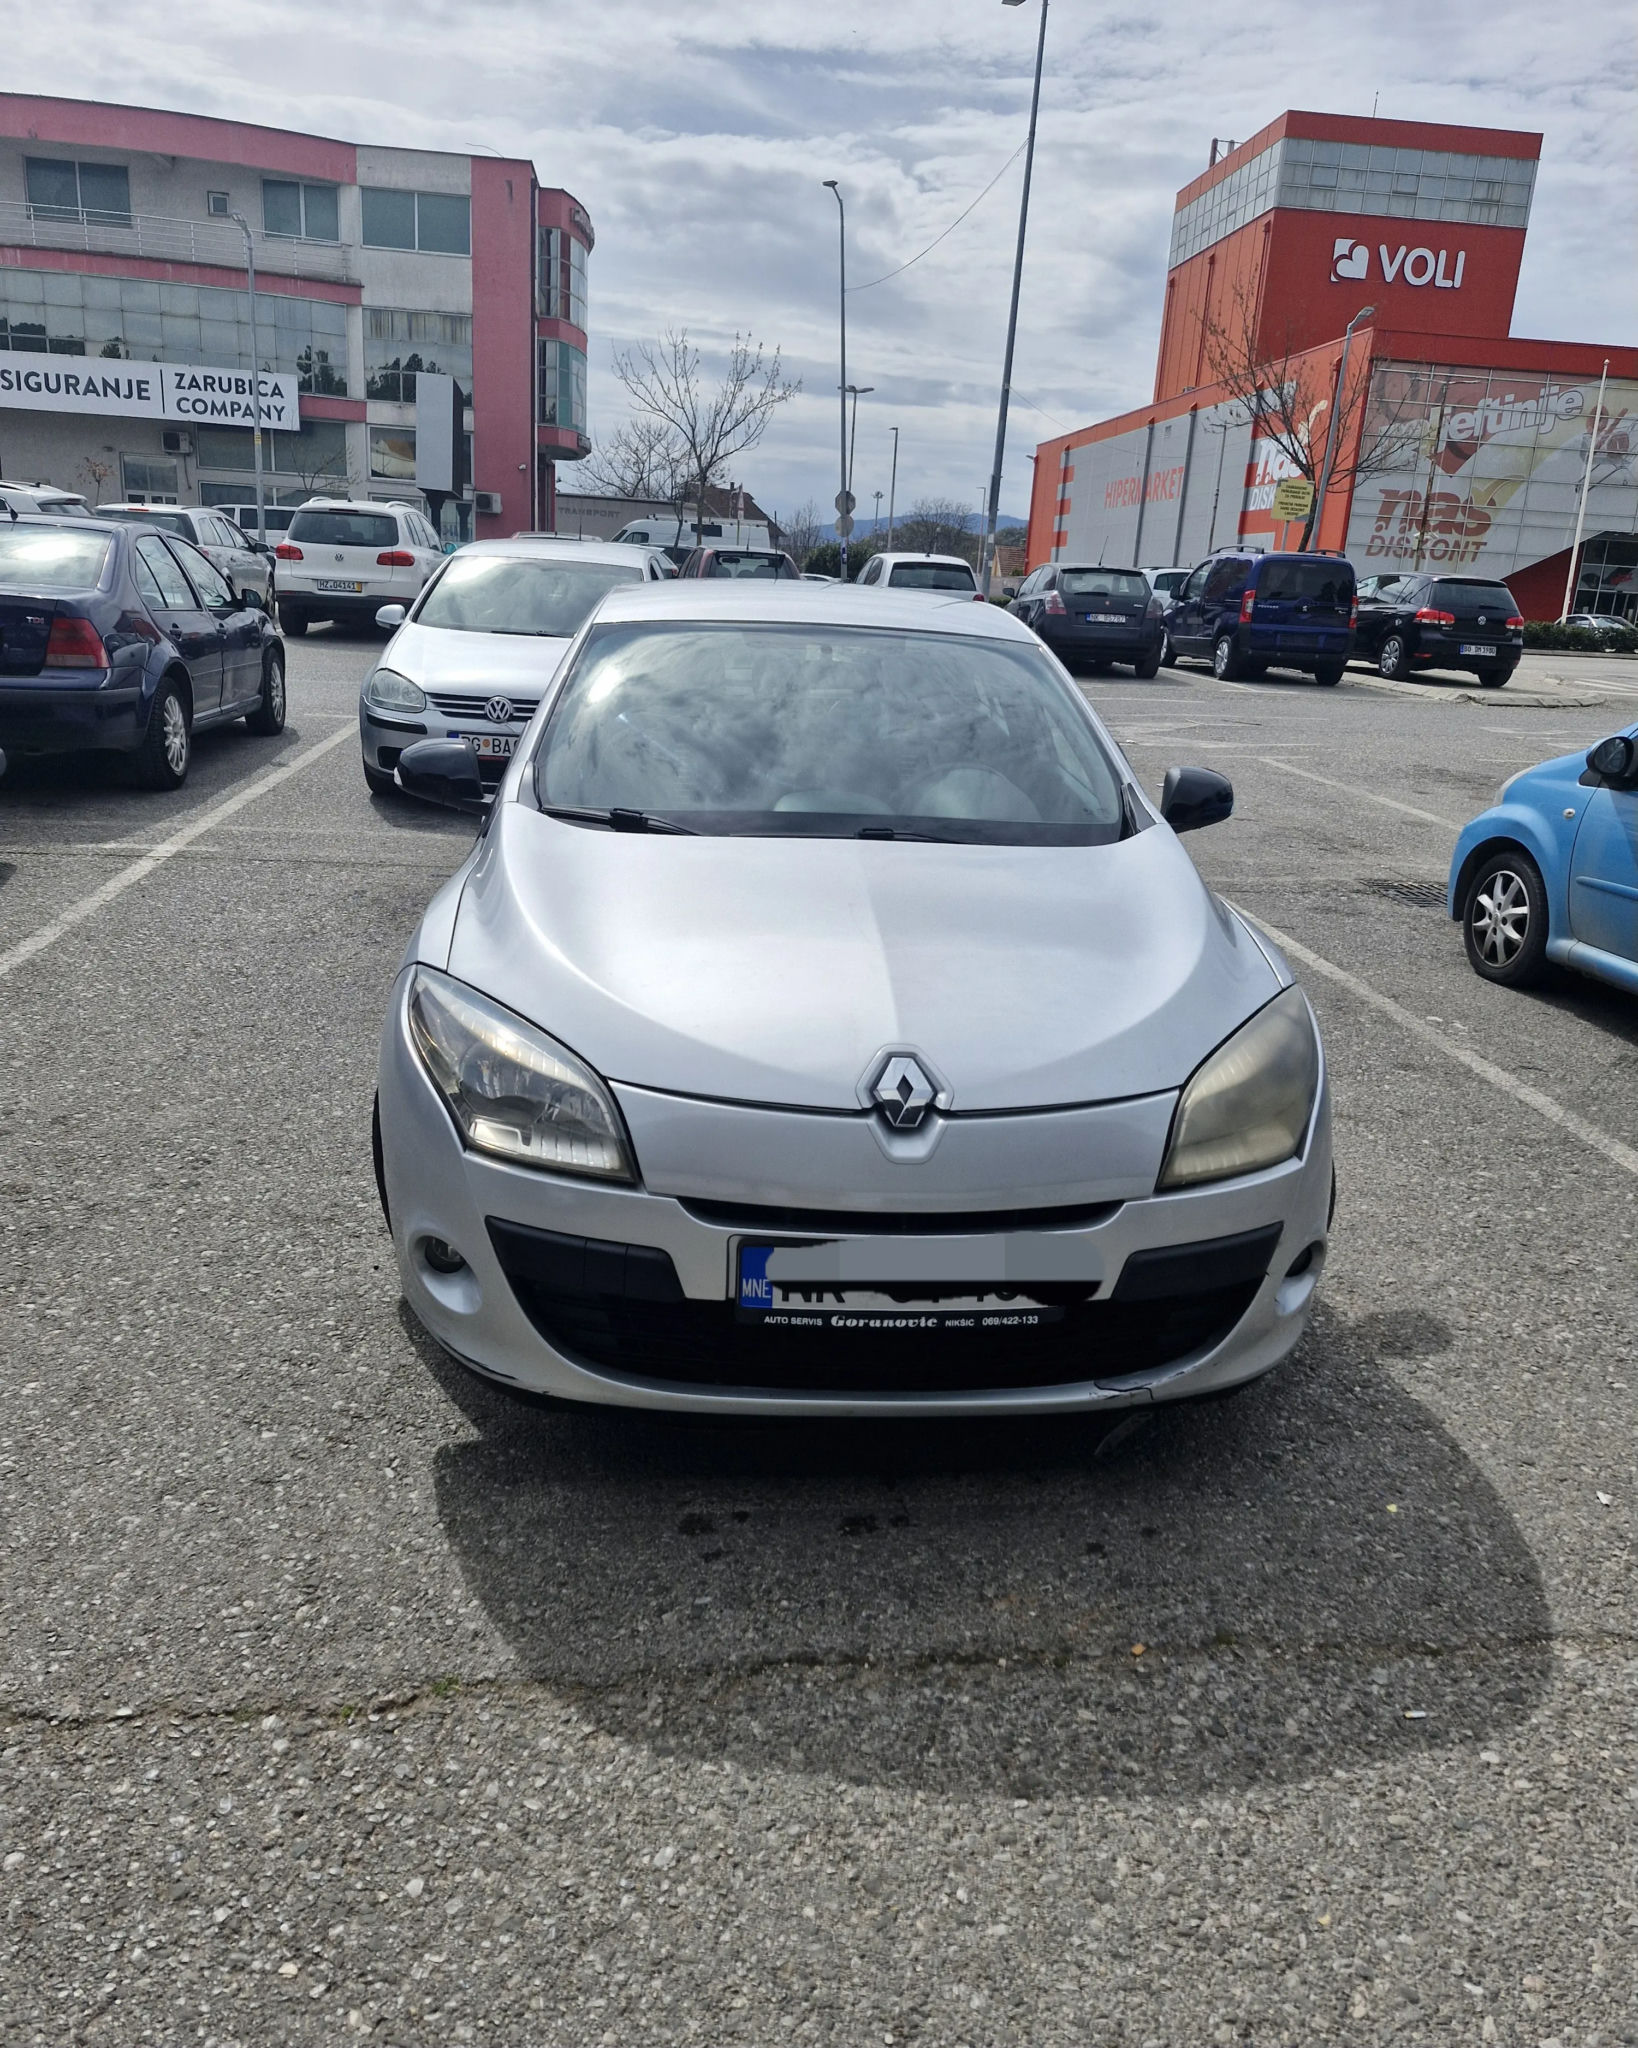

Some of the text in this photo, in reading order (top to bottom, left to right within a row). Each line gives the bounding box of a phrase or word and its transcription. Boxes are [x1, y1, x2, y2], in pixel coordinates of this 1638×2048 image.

[1379, 244, 1466, 288] VOLI
[1, 369, 151, 400] SIGURANJE
[174, 372, 285, 398] ZARUBICA
[176, 397, 286, 422] COMPANY
[1365, 534, 1488, 563] DISKONT
[742, 1278, 772, 1298] MNE
[764, 1315, 789, 1324] AUTO
[790, 1316, 823, 1326] SERVIS
[982, 1315, 1039, 1326] 069/422-133
